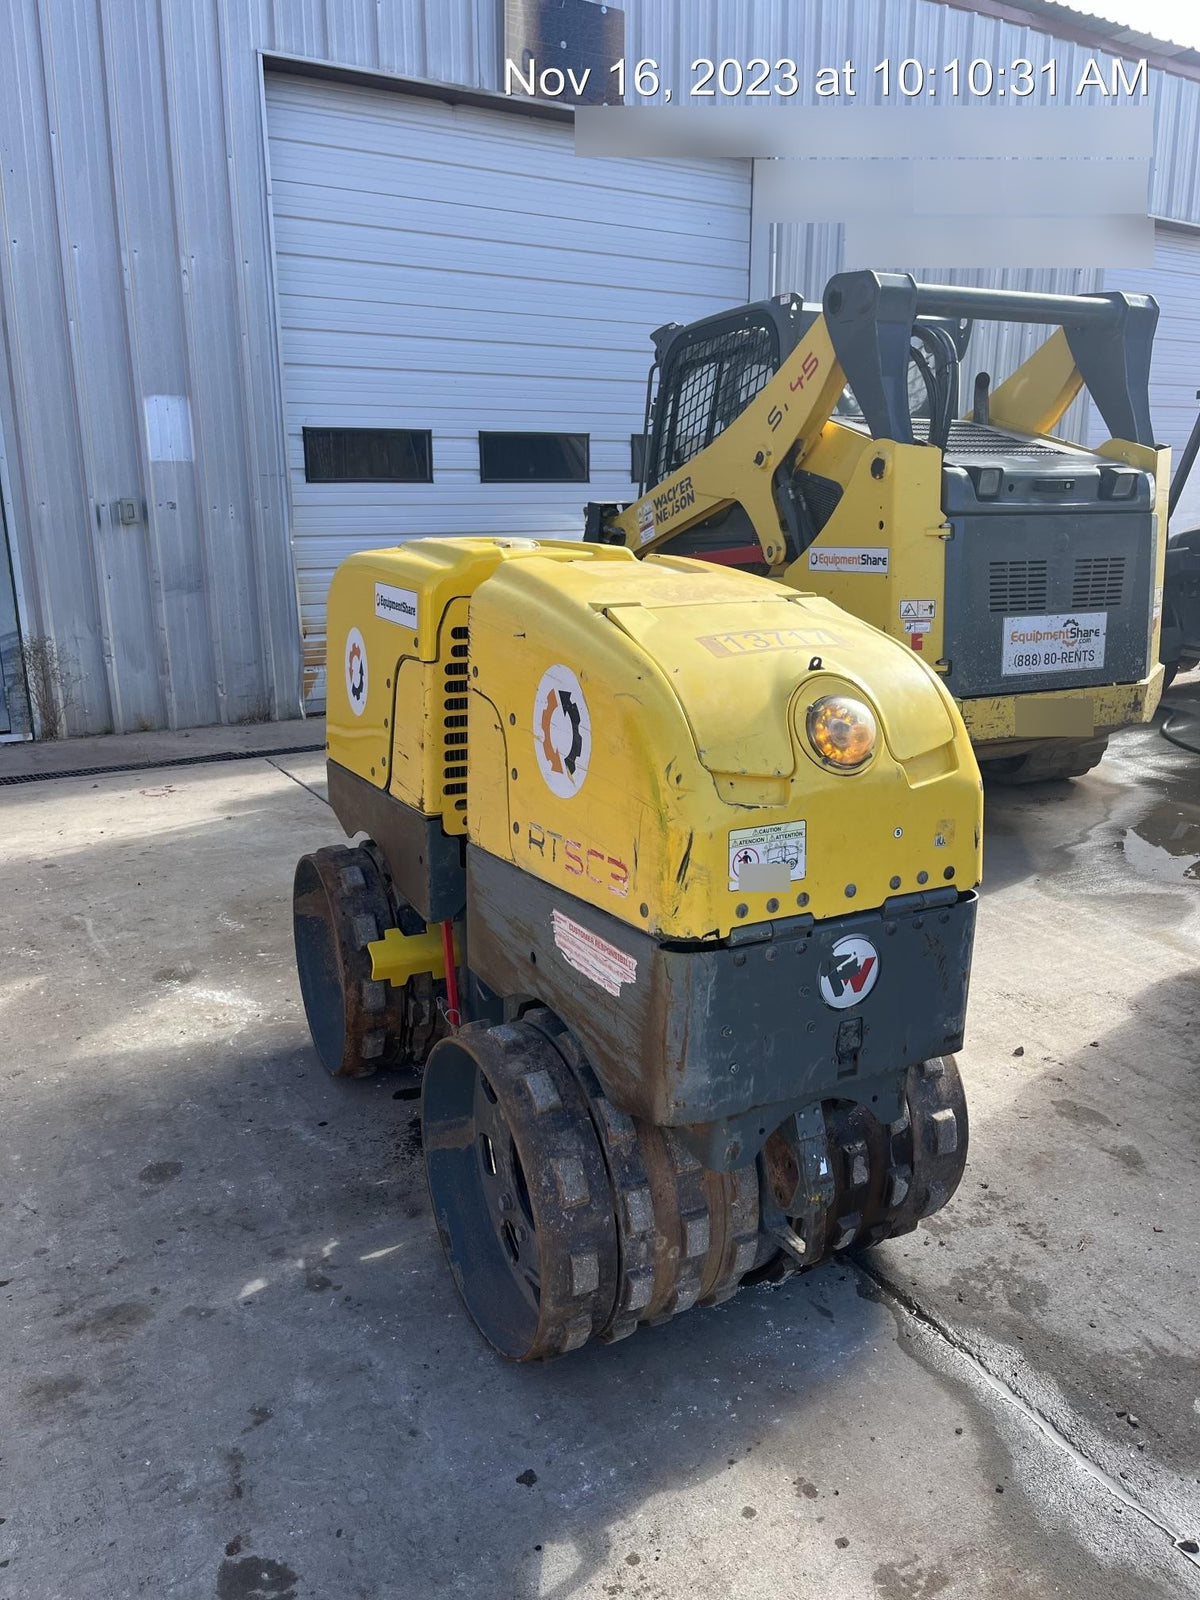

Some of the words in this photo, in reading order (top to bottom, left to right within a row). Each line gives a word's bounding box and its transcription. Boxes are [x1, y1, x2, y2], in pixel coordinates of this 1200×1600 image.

[818, 553, 887, 567] EquipmentShare
[380, 595, 416, 616] EquipmentShare
[723, 631, 827, 650] 13717
[1010, 627, 1101, 644] EquipmentShare
[1014, 653, 1041, 668] (888)
[1043, 649, 1095, 665] 80-RENTS
[758, 826, 782, 834] CAUTION
[775, 831, 803, 840] ATTENTION
